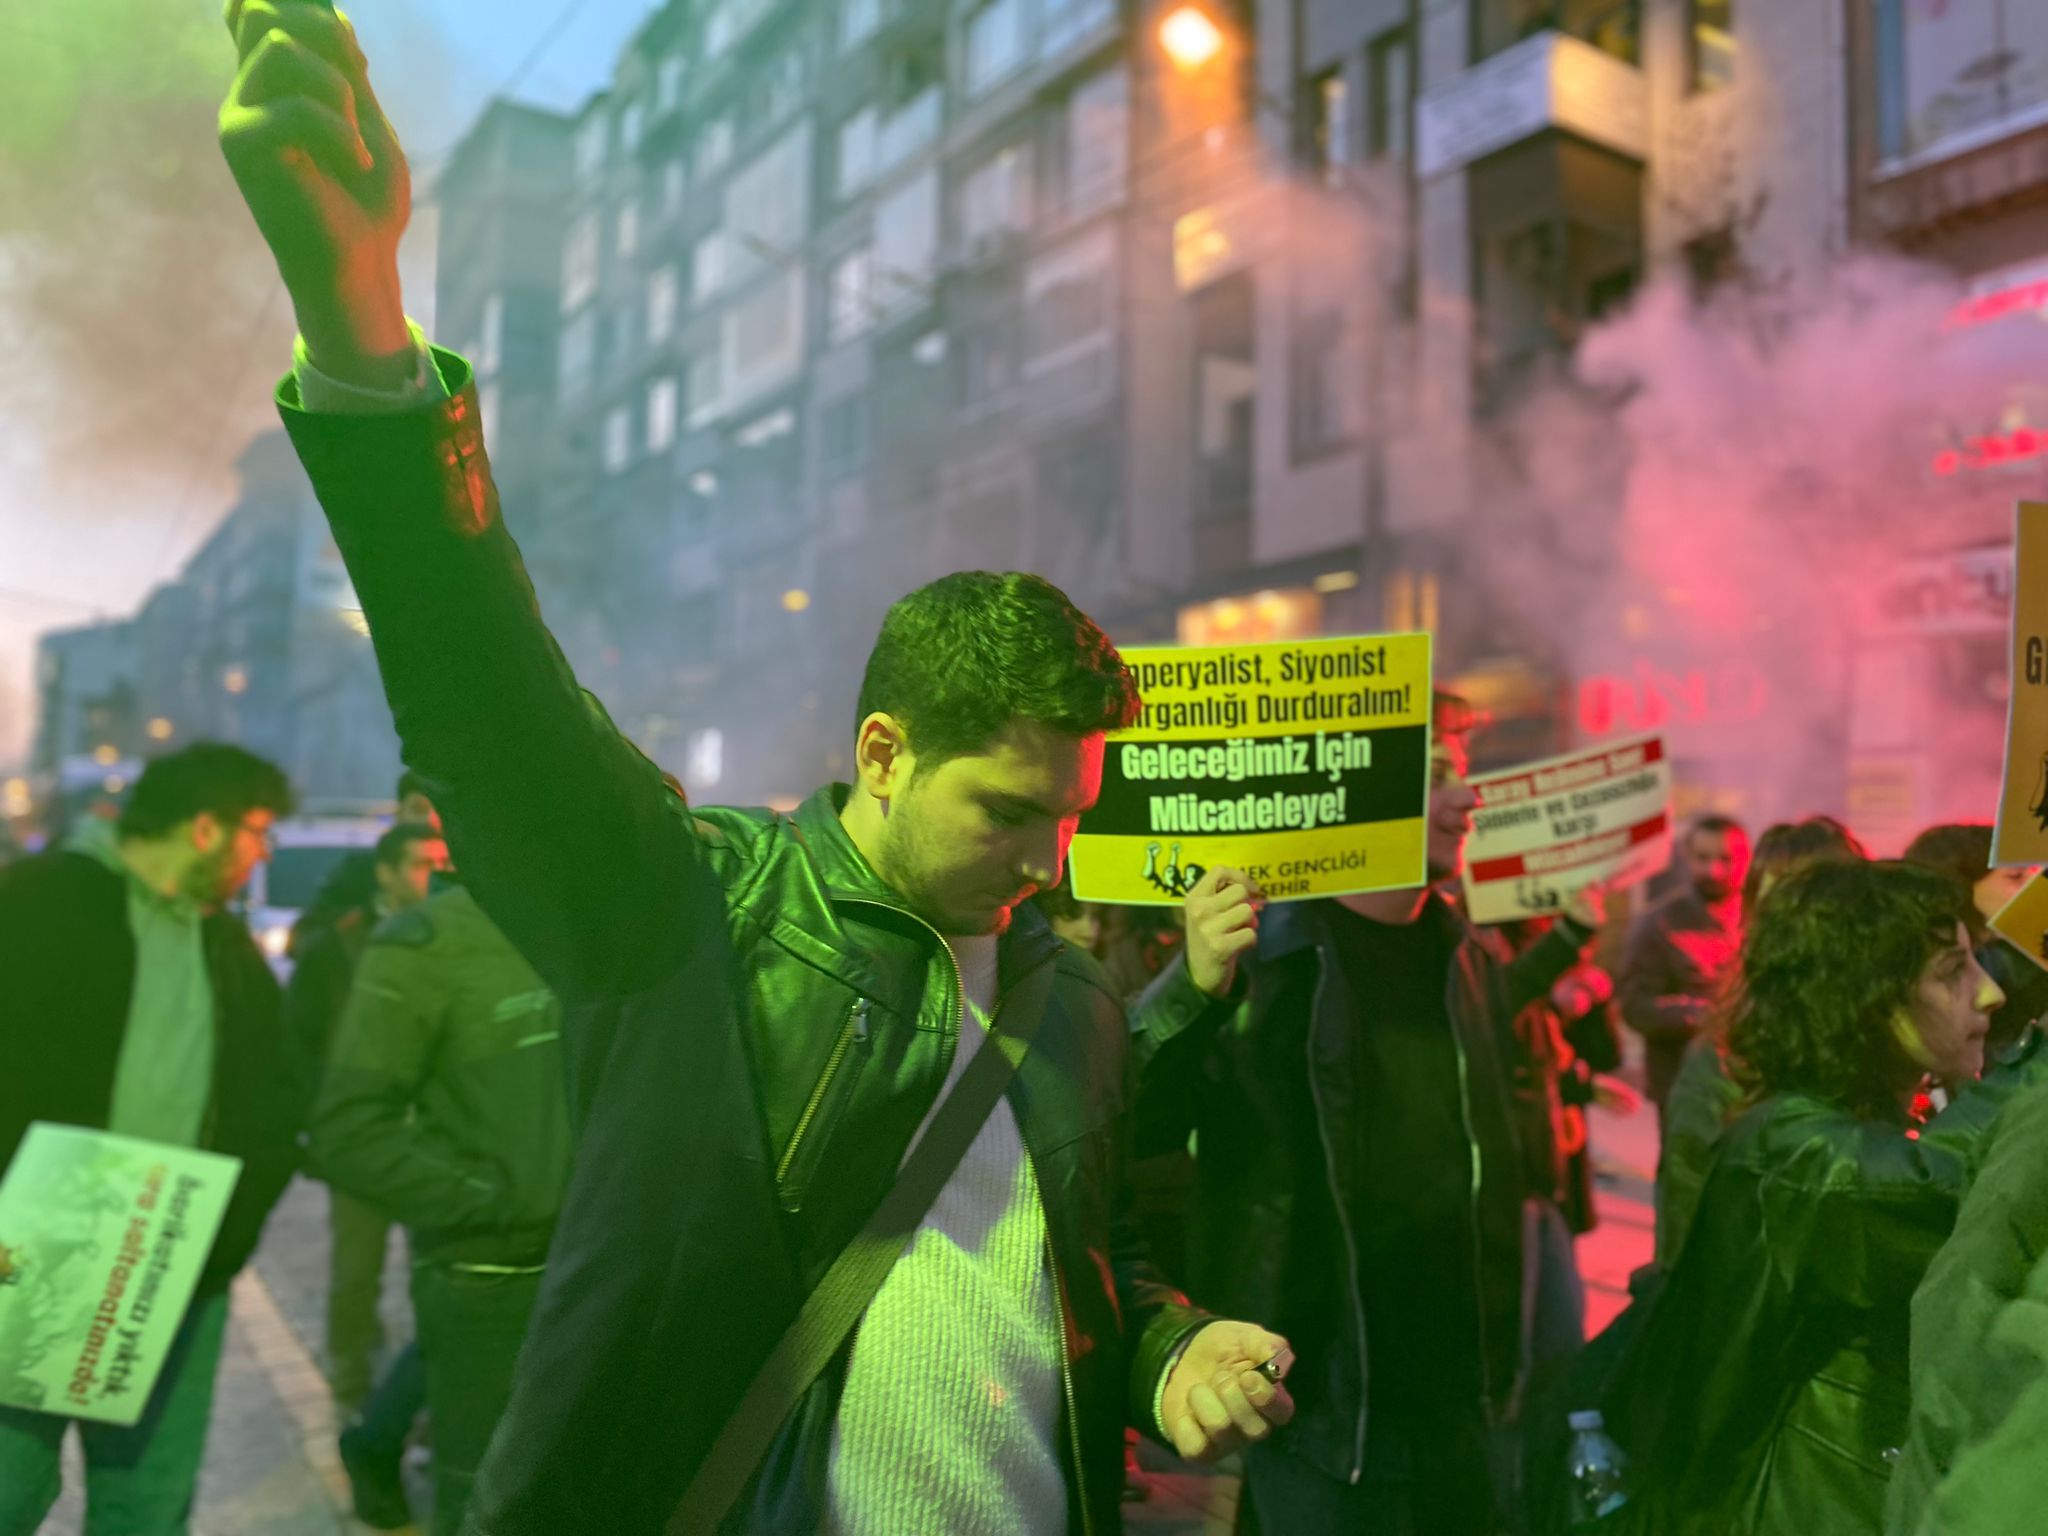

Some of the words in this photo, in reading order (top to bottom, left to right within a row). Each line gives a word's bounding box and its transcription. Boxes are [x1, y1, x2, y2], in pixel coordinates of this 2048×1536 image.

[1280, 645, 1387, 682] Siyonist
[2026, 635, 2048, 686] G
[1257, 684, 1411, 724] Durduralım!
[1120, 735, 1310, 782] Geleceğimiz
[1314, 729, 1373, 783] İçin
[1149, 786, 1347, 832] Mücadeleye!
[1240, 863, 1271, 881] EK
[1278, 849, 1367, 877] GENÇLİĞİ
